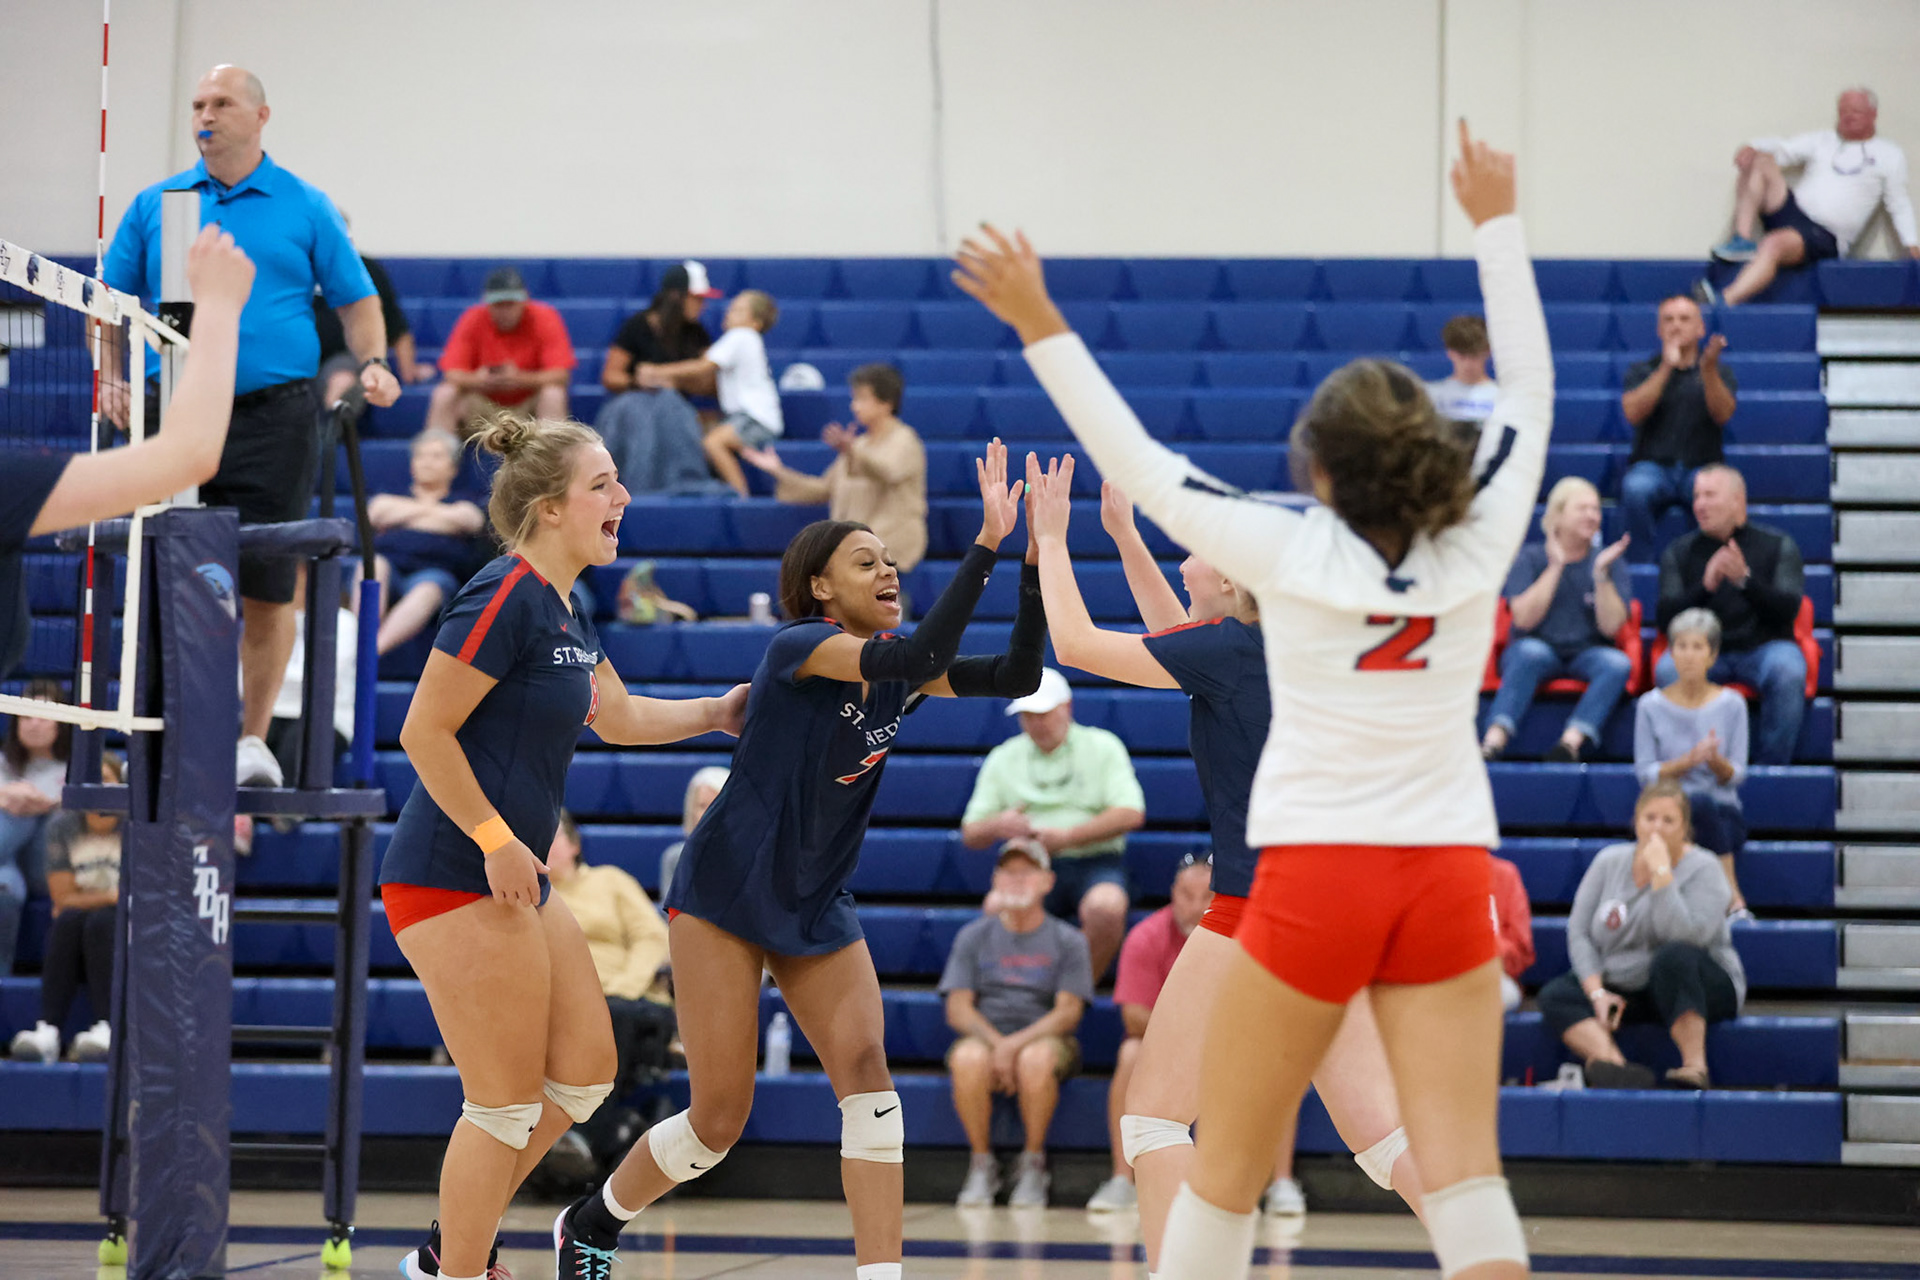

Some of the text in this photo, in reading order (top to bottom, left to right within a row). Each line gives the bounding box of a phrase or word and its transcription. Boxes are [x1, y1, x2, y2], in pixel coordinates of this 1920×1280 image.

[553, 647, 575, 665] ST.
[1354, 614, 1436, 670] 2
[840, 702, 862, 730] ST.
